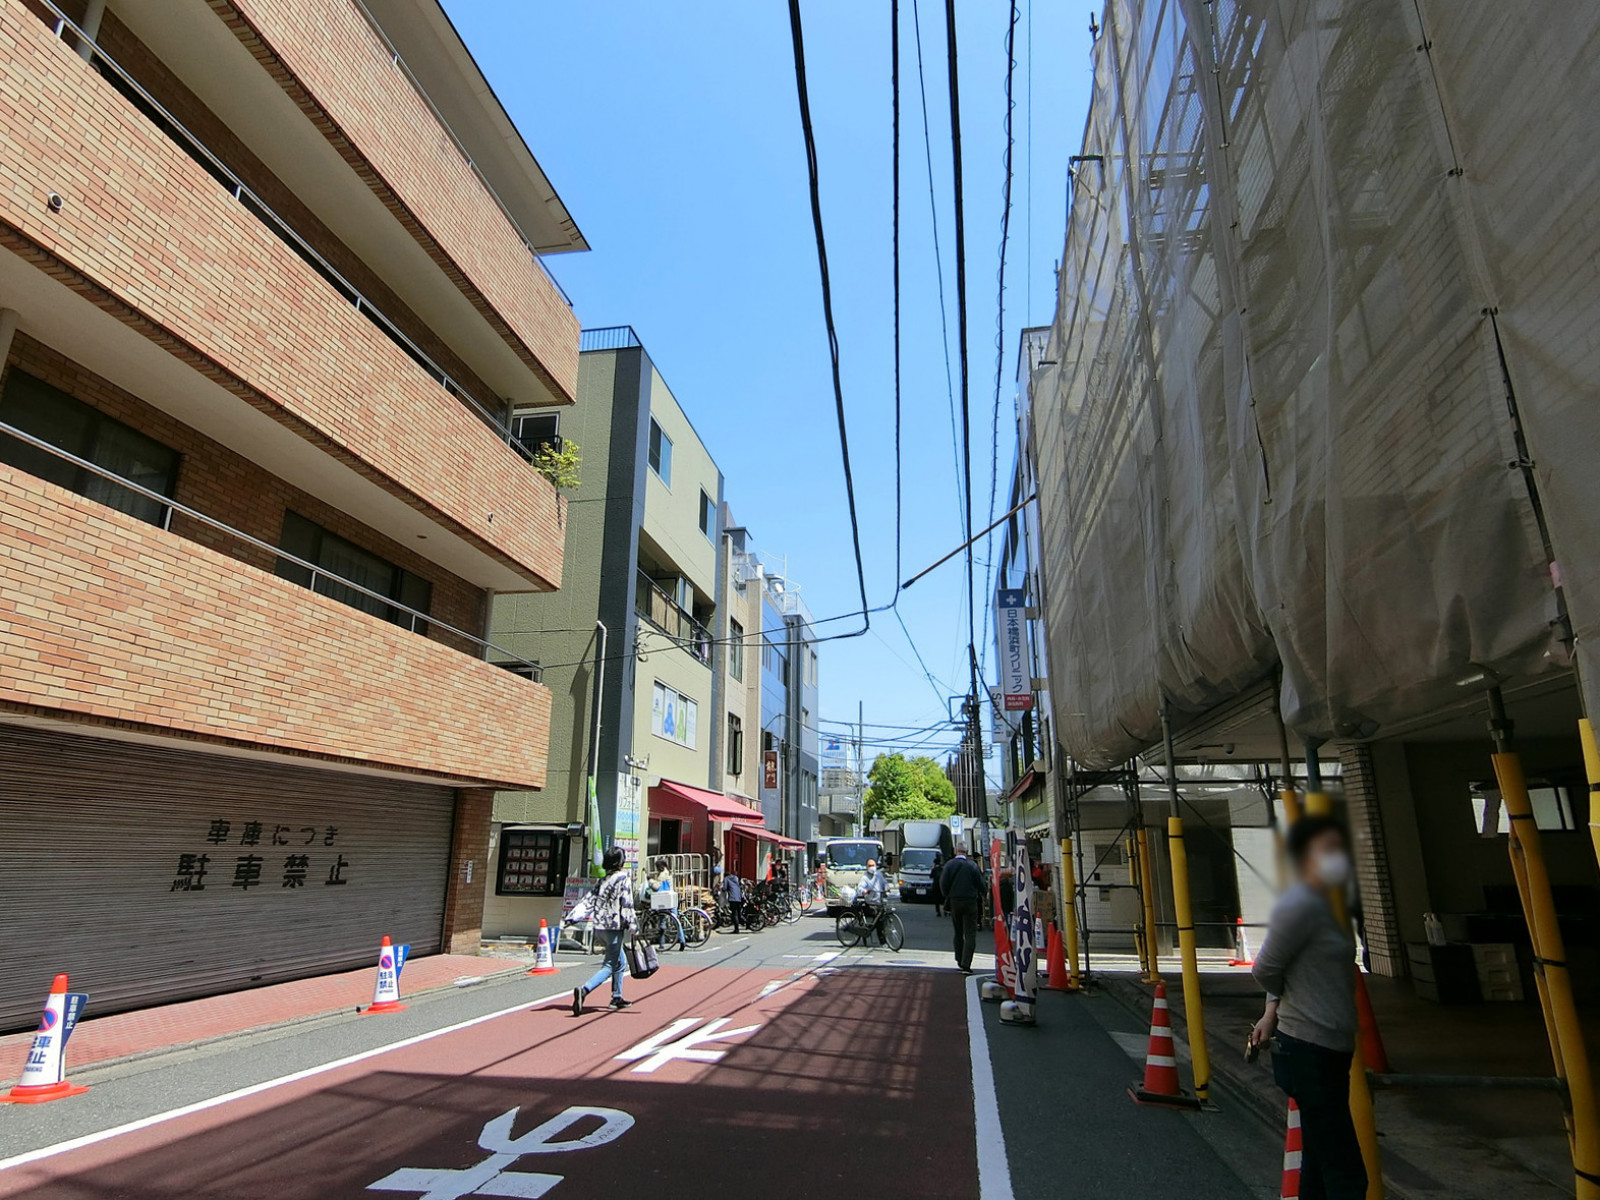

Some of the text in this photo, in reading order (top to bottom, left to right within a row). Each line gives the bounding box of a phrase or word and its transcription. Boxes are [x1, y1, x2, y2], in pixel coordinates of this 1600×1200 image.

[206, 819, 338, 847] 車庫につき
[170, 853, 349, 892] 駐車禁止
